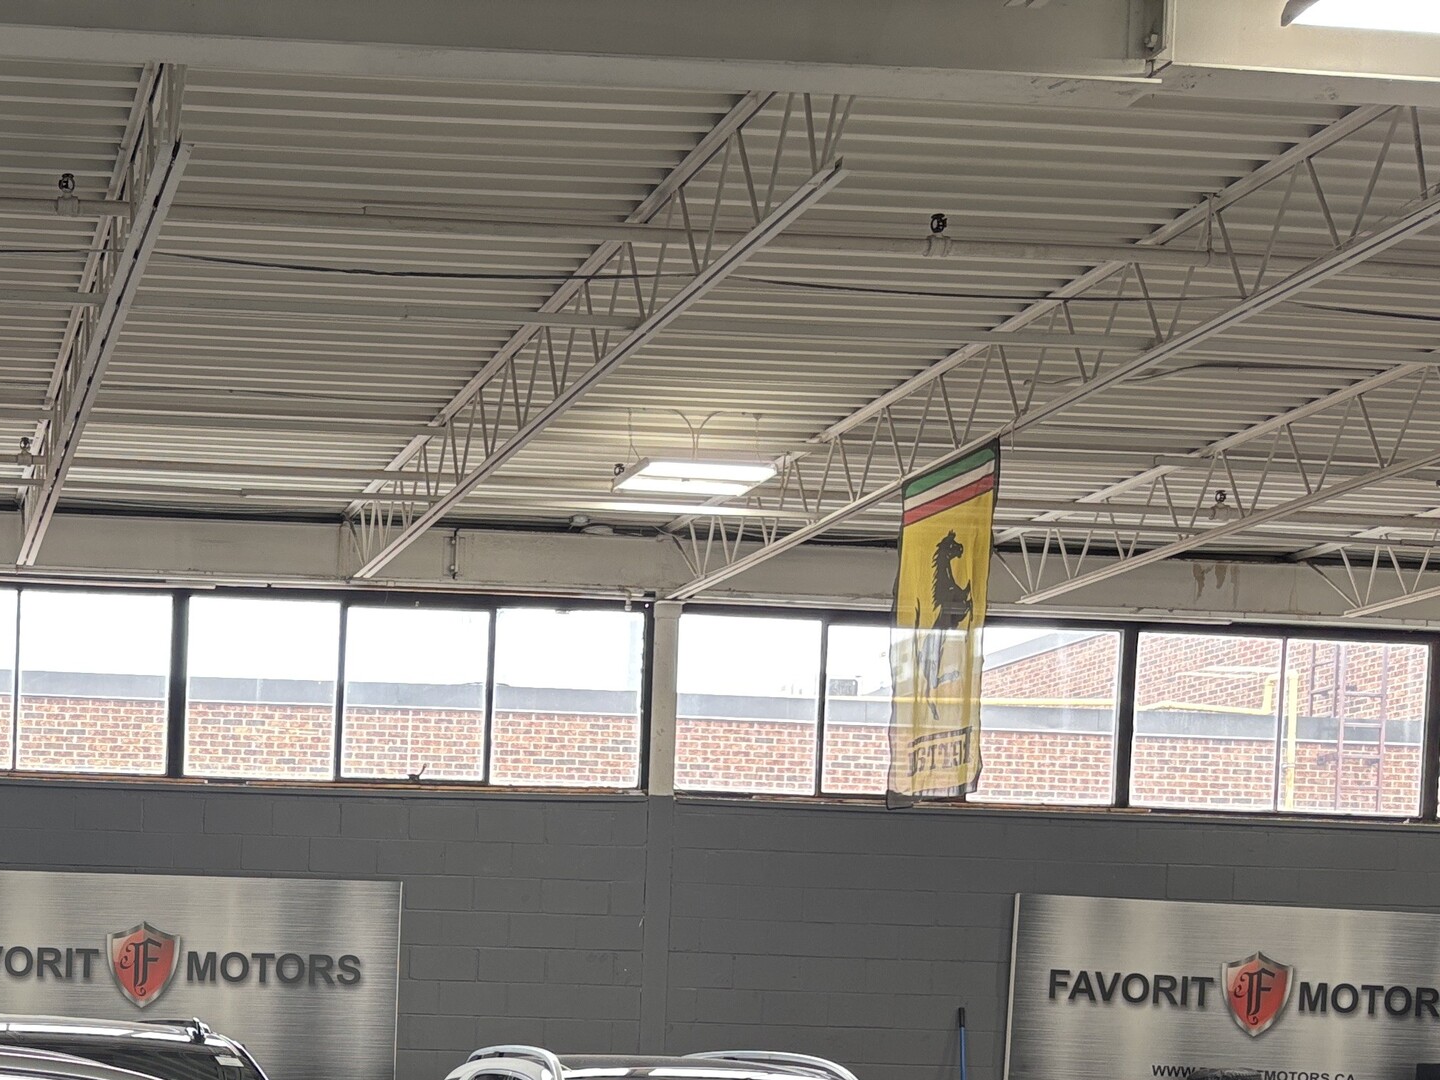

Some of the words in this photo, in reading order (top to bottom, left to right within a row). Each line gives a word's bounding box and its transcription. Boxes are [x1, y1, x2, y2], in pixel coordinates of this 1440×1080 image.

[187, 951, 361, 985] MOTORS
[1048, 969, 1215, 1008] FAVORIT
[1298, 981, 1440, 1018] MOTOR
